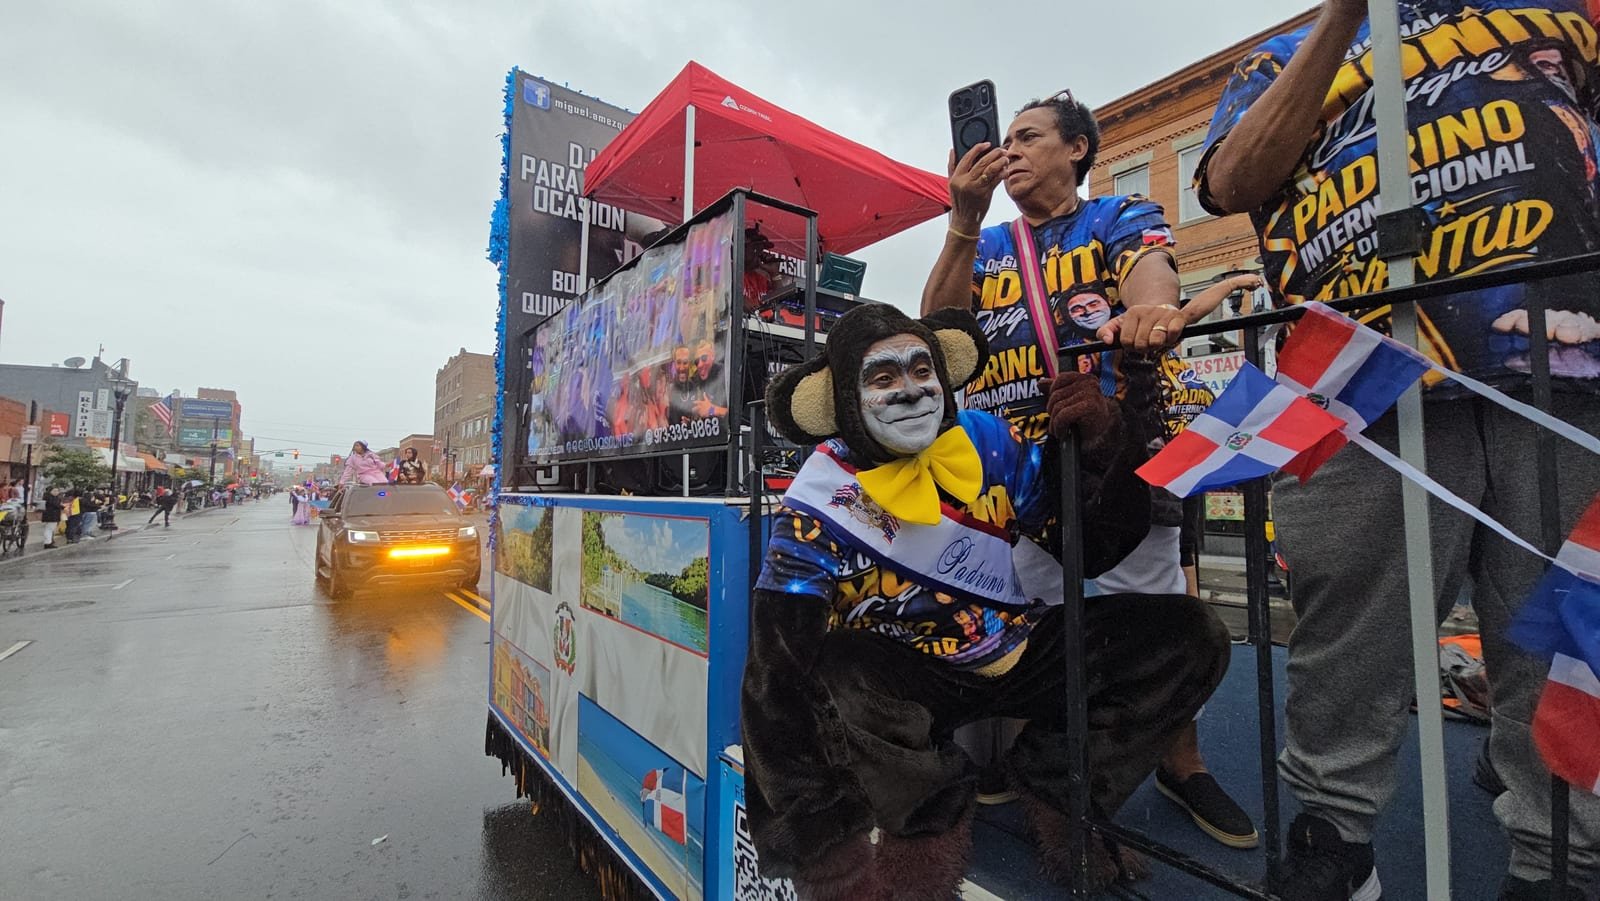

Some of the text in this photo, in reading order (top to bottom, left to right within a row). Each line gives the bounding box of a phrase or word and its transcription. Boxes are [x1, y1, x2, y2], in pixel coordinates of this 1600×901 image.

[521, 154, 579, 195] PARA
[533, 185, 625, 232] OCASION
[1300, 142, 1535, 274] INTERNCIONAL
[1189, 354, 1245, 375] ESTAU
[653, 416, 720, 444] 973-336-0868
[937, 536, 1006, 594] Padrino
